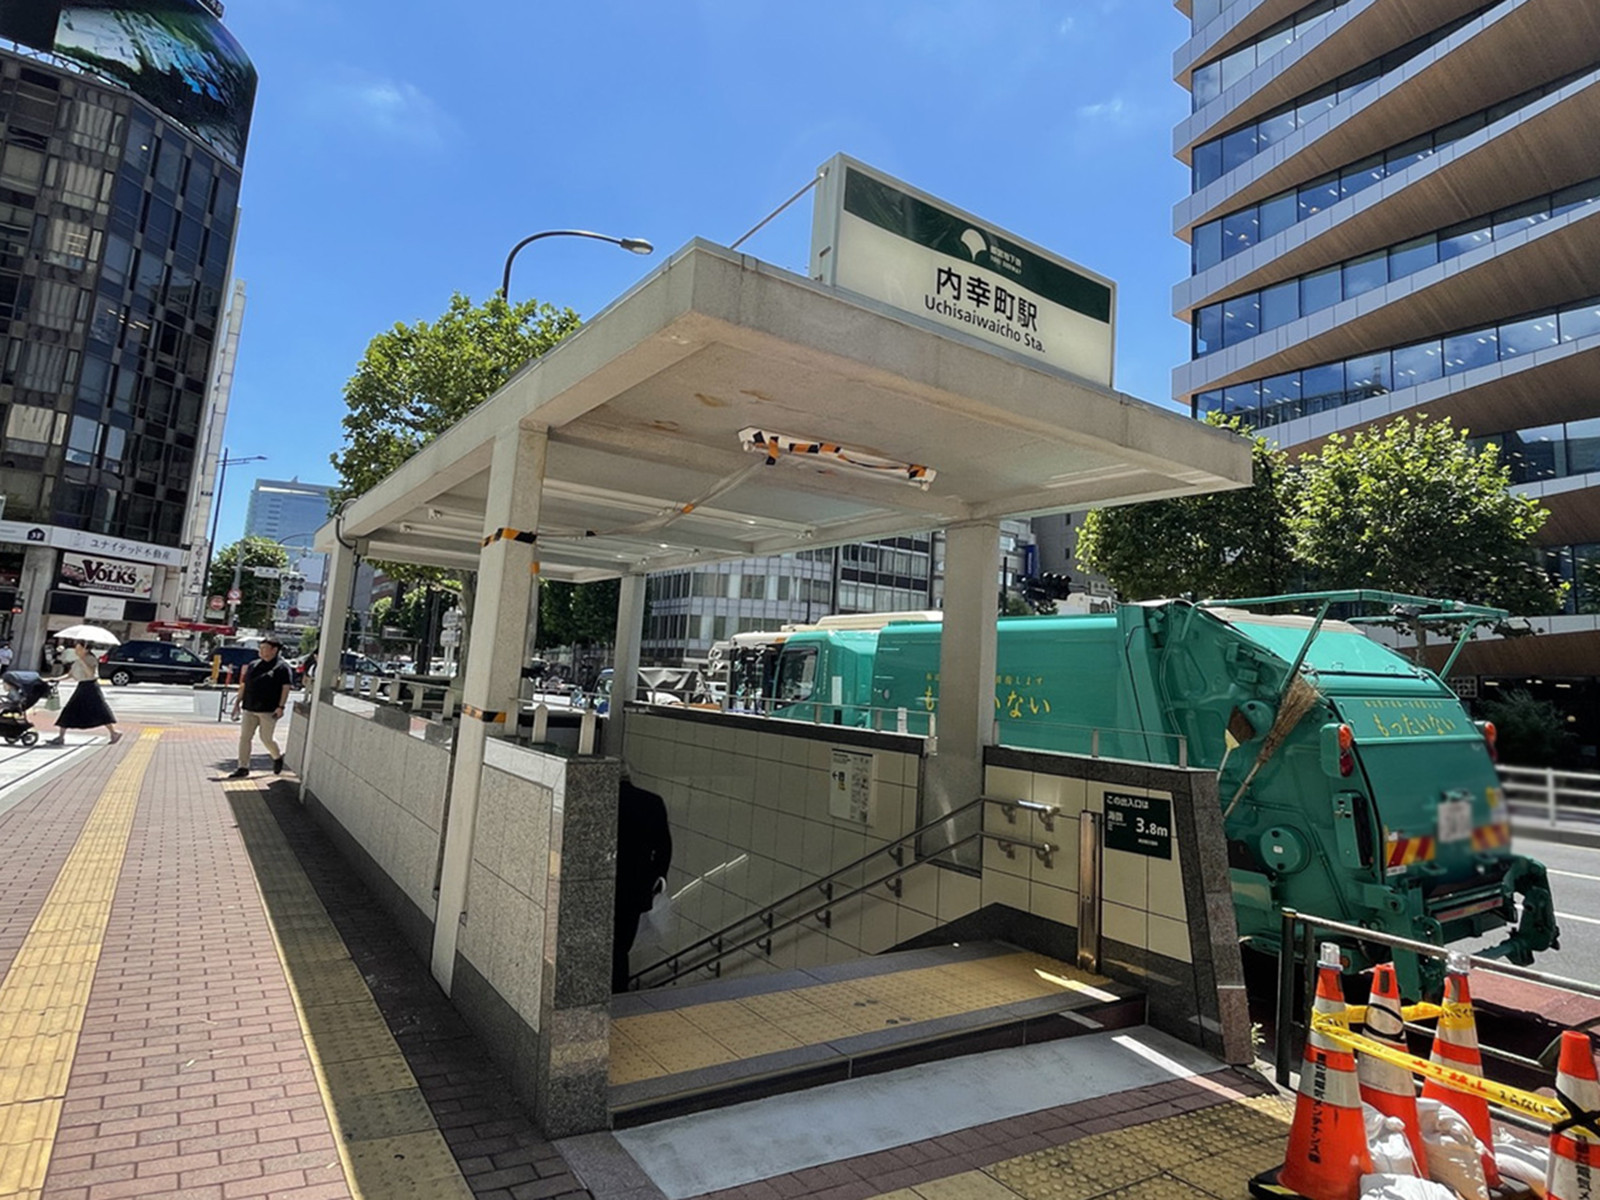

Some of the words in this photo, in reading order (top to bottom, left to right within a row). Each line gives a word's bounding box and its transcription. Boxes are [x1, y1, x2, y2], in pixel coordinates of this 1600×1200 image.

[936, 266, 1038, 332] 内幸町駅
[924, 294, 1021, 343] Uchisaiwaicho
[1024, 332, 1046, 353] Sta.
[82, 559, 137, 585] VOLKS
[1373, 714, 1456, 737] もったいない
[1135, 816, 1169, 838] 3.8m
